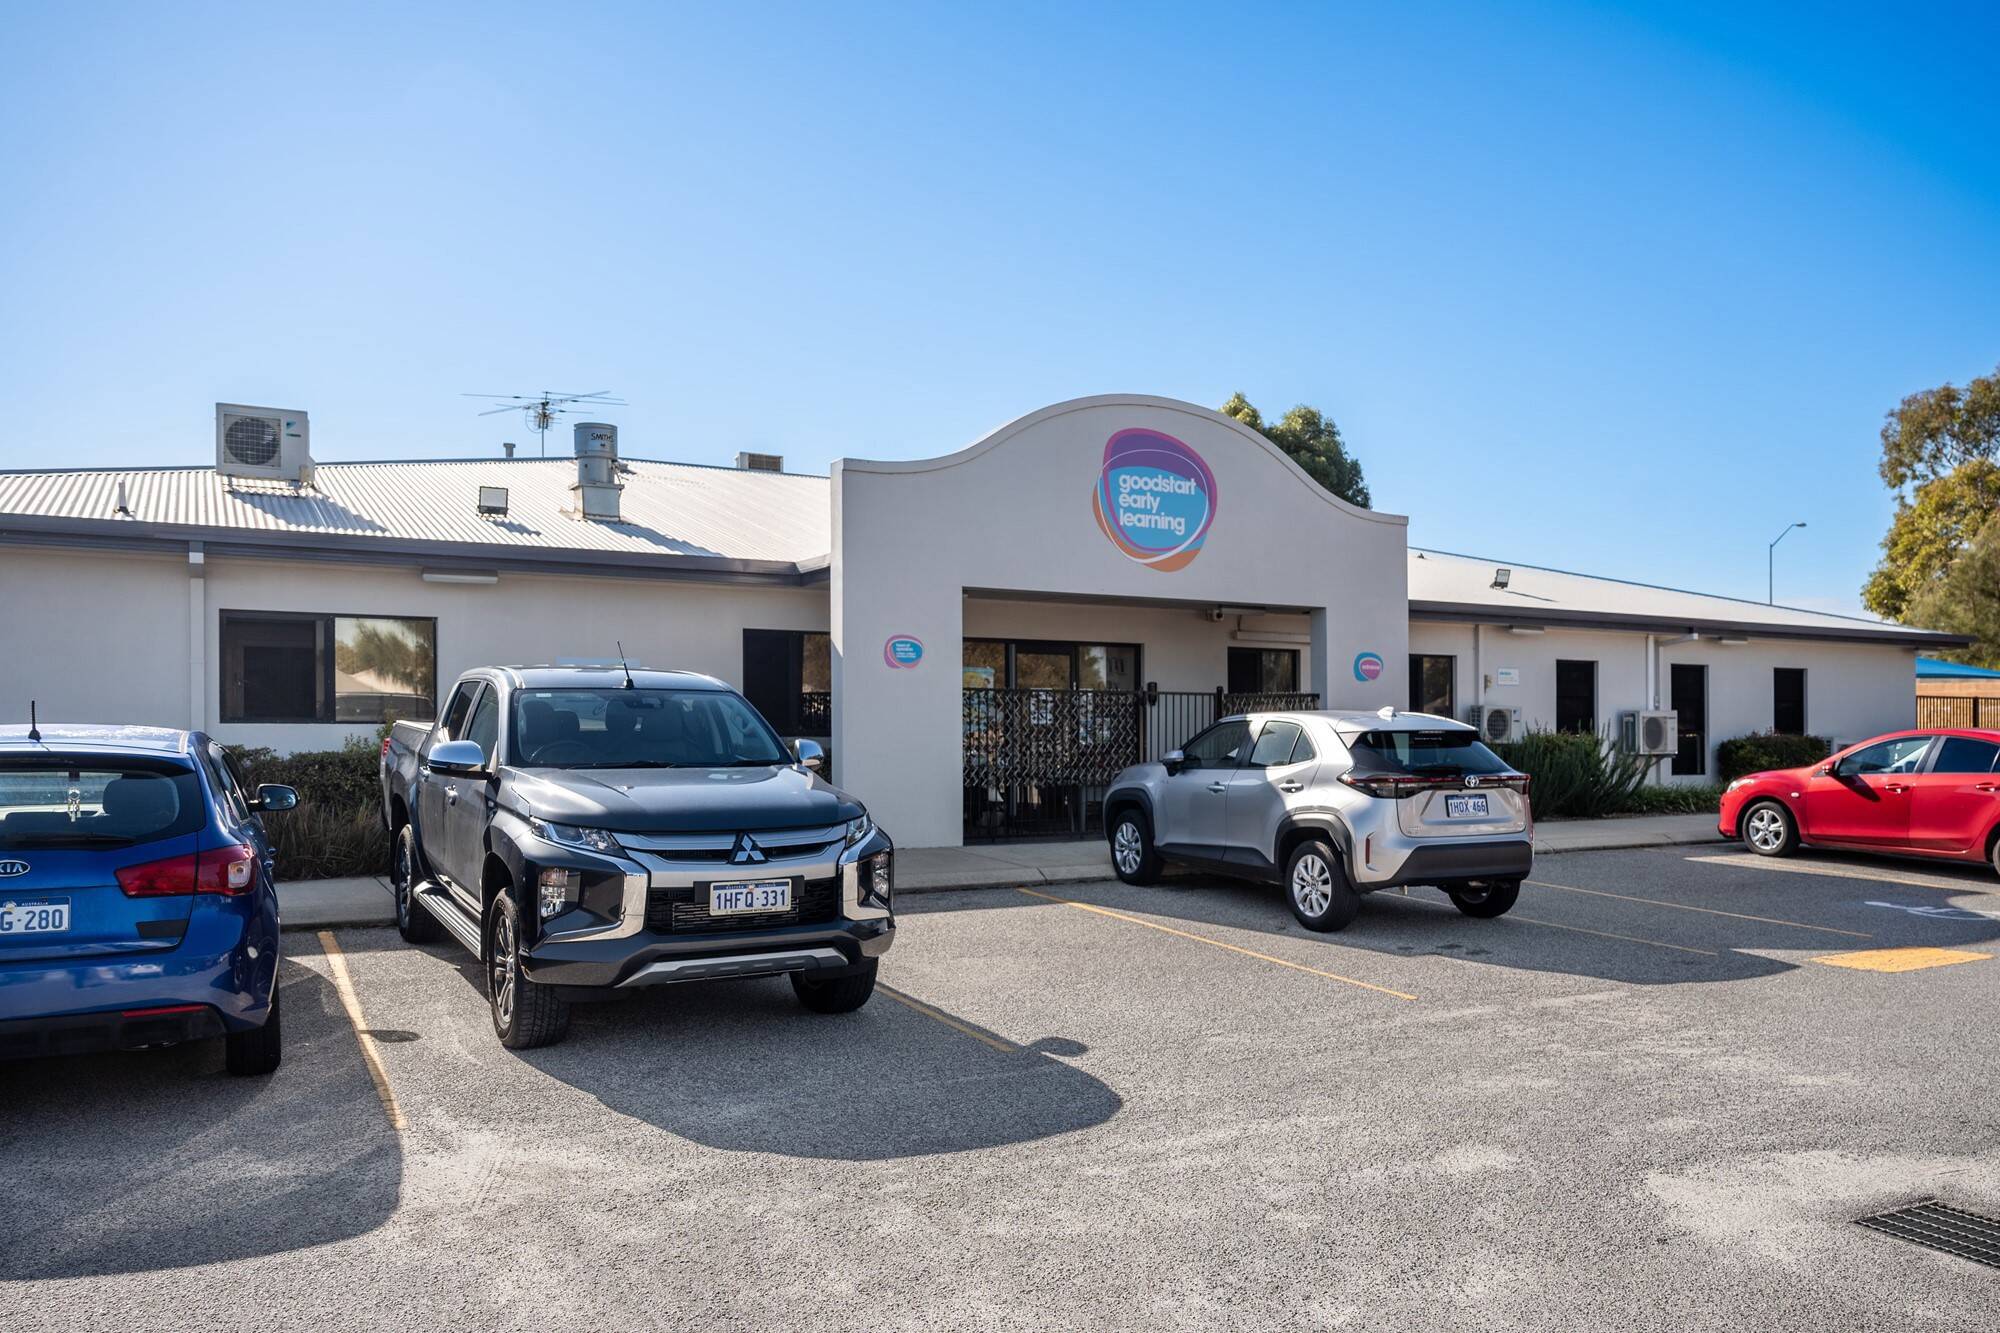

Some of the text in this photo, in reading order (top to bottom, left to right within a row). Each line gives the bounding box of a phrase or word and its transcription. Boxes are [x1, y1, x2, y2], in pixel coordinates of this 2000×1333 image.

[1118, 474, 1196, 495] goodstart
[1118, 492, 1160, 513] early
[1119, 508, 1185, 535] learning
